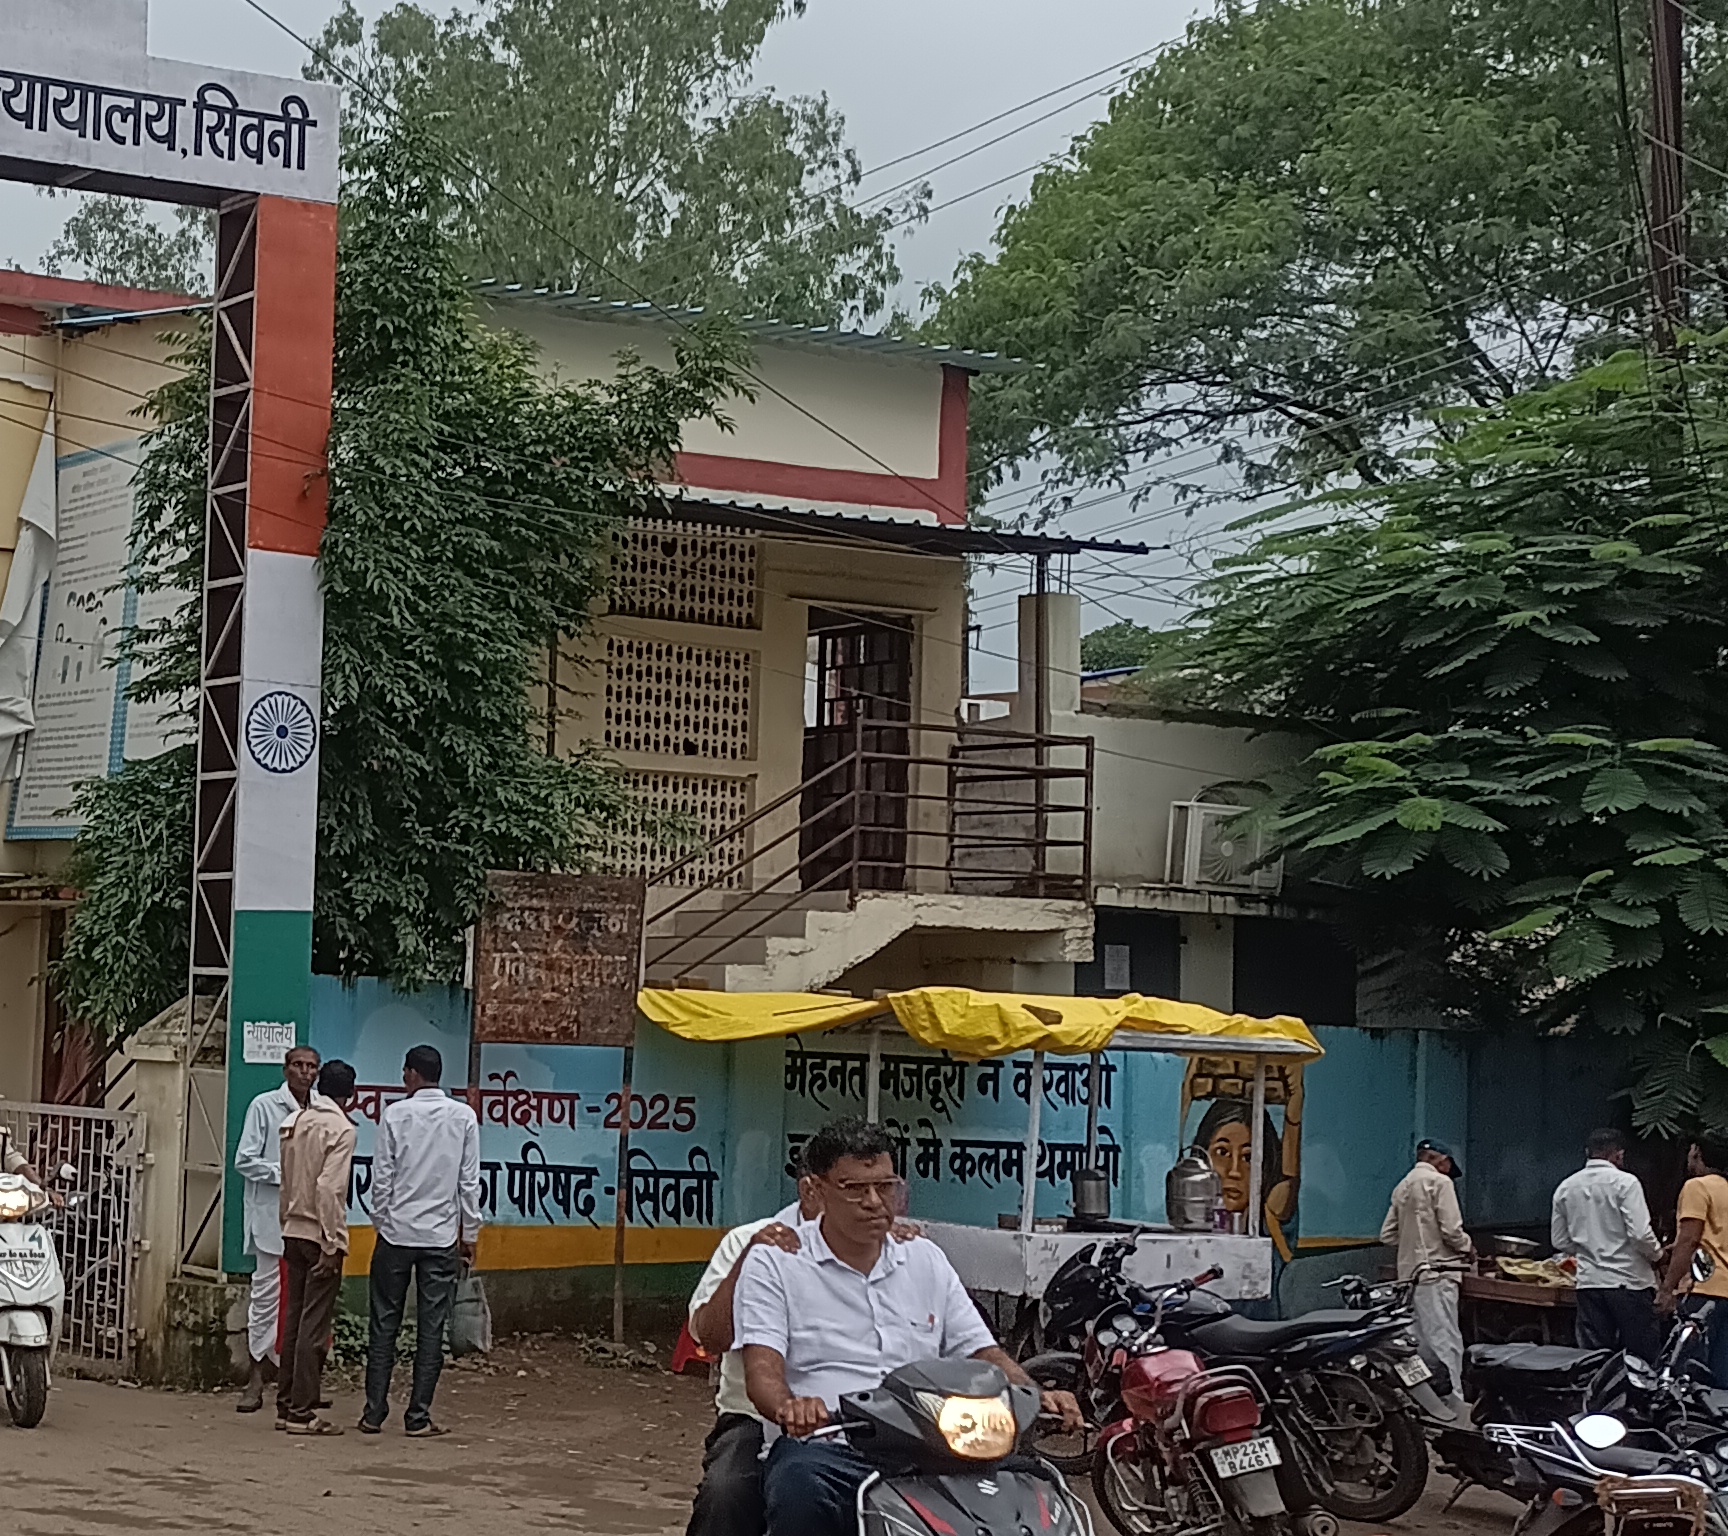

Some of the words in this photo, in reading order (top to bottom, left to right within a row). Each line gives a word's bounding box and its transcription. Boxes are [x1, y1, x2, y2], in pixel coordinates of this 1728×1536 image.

[192, 82, 318, 171] सिवनी
[246, 1024, 293, 1045] न्यायालय
[784, 1033, 871, 1112] मेहनत
[977, 1058, 1006, 1105] न
[506, 1141, 601, 1230] परिषद
[624, 1146, 720, 1229] सिवनी
[949, 1137, 1028, 1190] कलम
